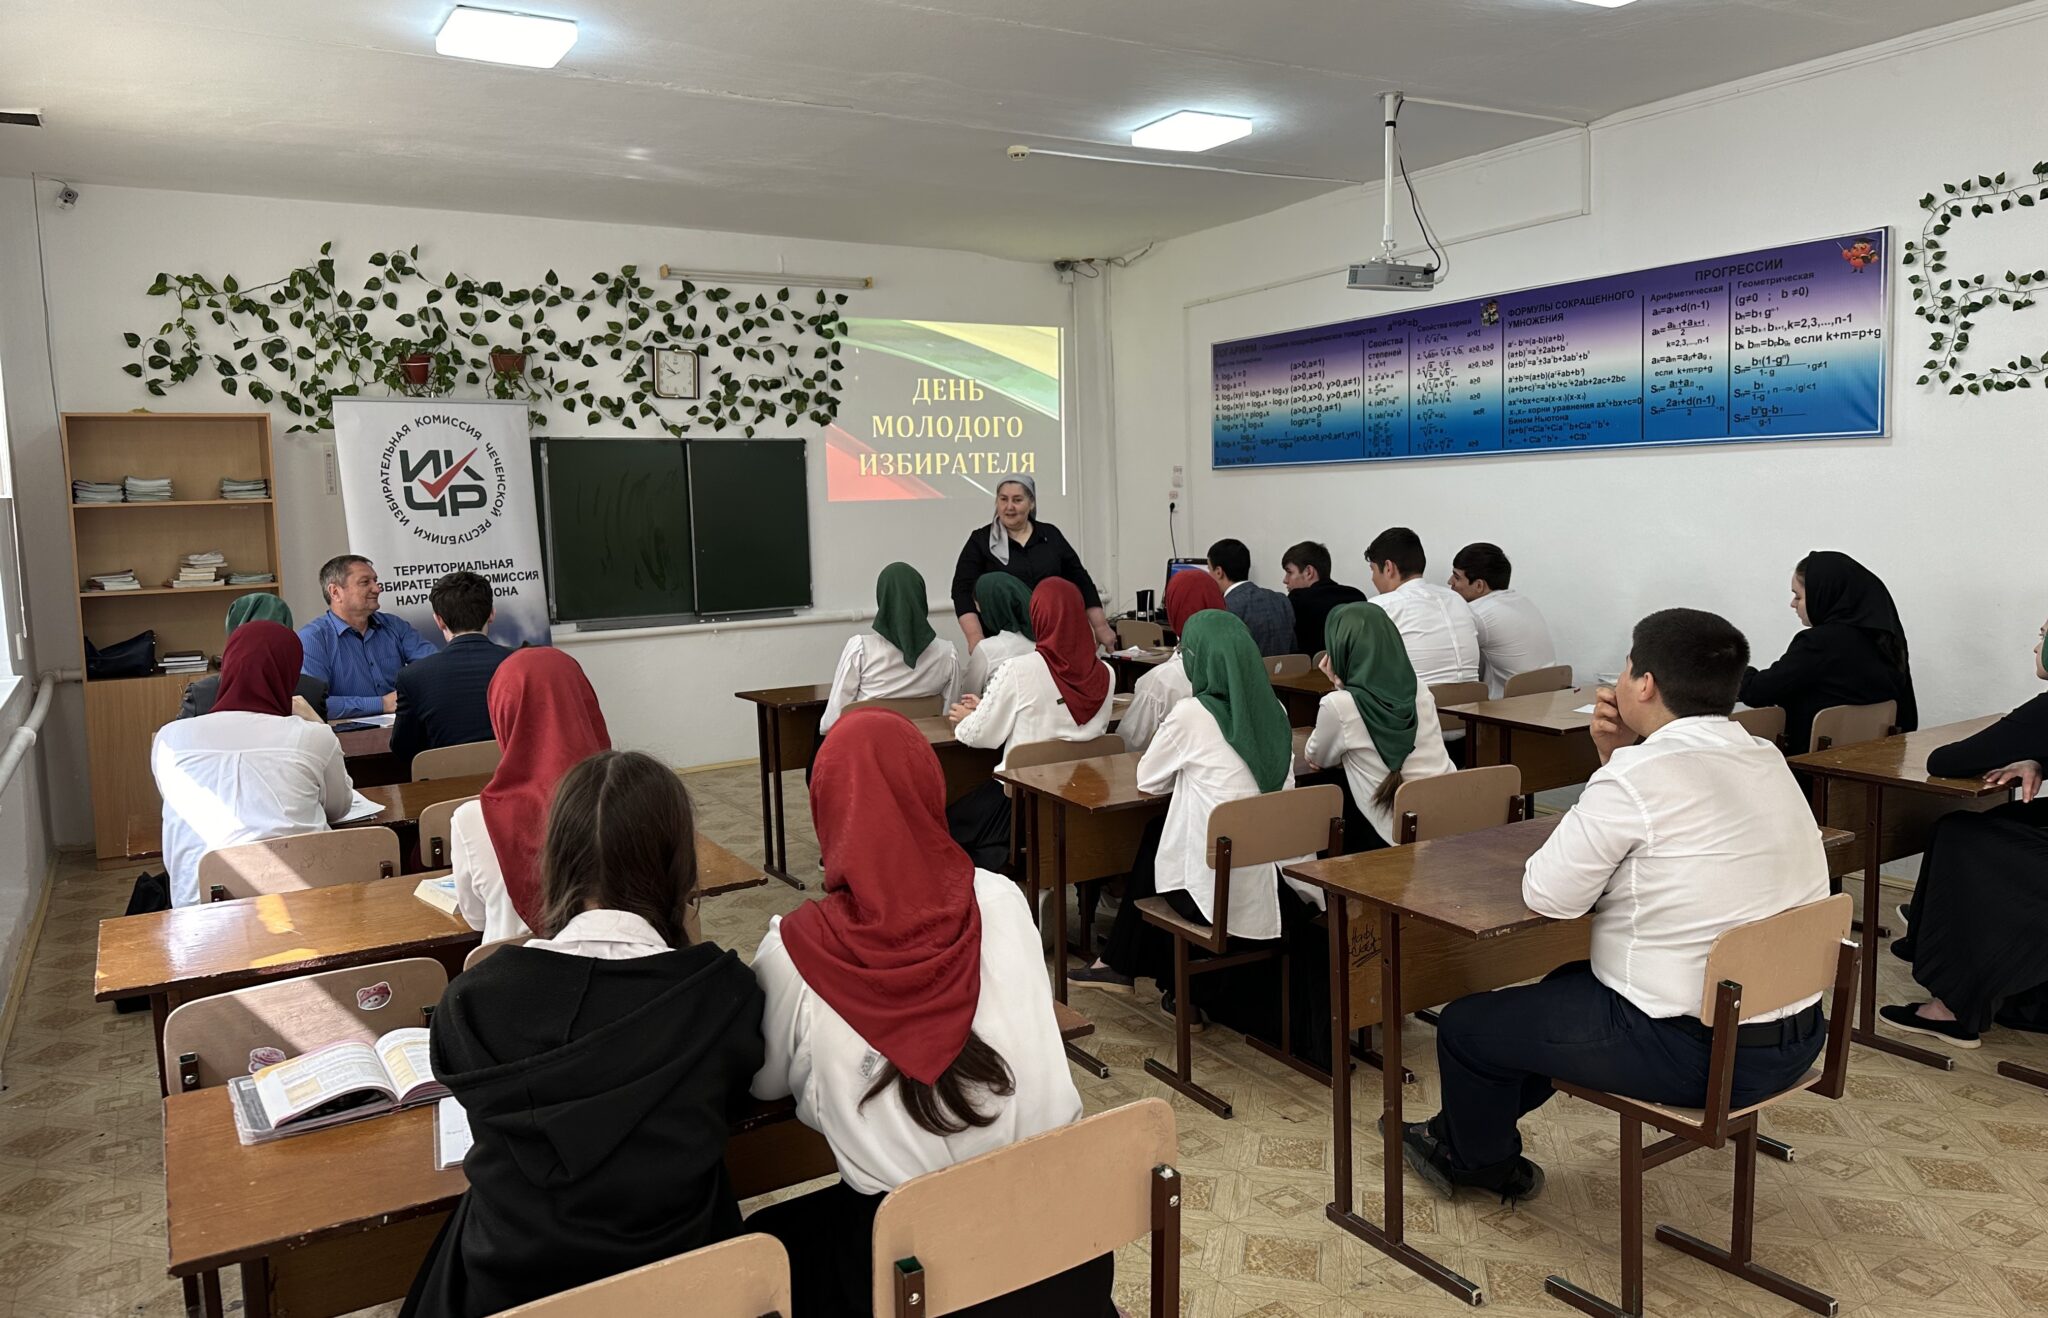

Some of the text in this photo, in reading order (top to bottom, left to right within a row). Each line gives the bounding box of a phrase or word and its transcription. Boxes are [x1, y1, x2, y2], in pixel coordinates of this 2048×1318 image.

[1694, 258, 1784, 281] ПРОГРЕССИИ
[1737, 271, 1815, 289] Геометрическая
[1507, 289, 1635, 317] ФОРМУЛЫ СОКРАЩЕННОГО
[1650, 285, 1724, 302] Арифметическая
[1507, 313, 1564, 329] УМНОЖЕНИЯ
[1367, 338, 1404, 349] Свойства
[1794, 335, 1823, 345] если
[1367, 348, 1402, 360] степеней
[912, 378, 984, 405] ДЕНЬ
[1552, 402, 1595, 413] уравнения
[871, 415, 1024, 443] МОЛОДОГО
[858, 452, 1036, 476] ИЗБИРАТЕЛЯ
[380, 414, 506, 545] ИЗБИРАТЕЛЬНАЯ КОМИССИЯ ЧЕЧЕНСКОЙ РЕСПУБЛИКИ
[393, 558, 514, 577] ТЕРРИТОРИАЛЬНАЯ
[377, 570, 539, 593] ЗБИРАТЕ ОМИССИЯ
